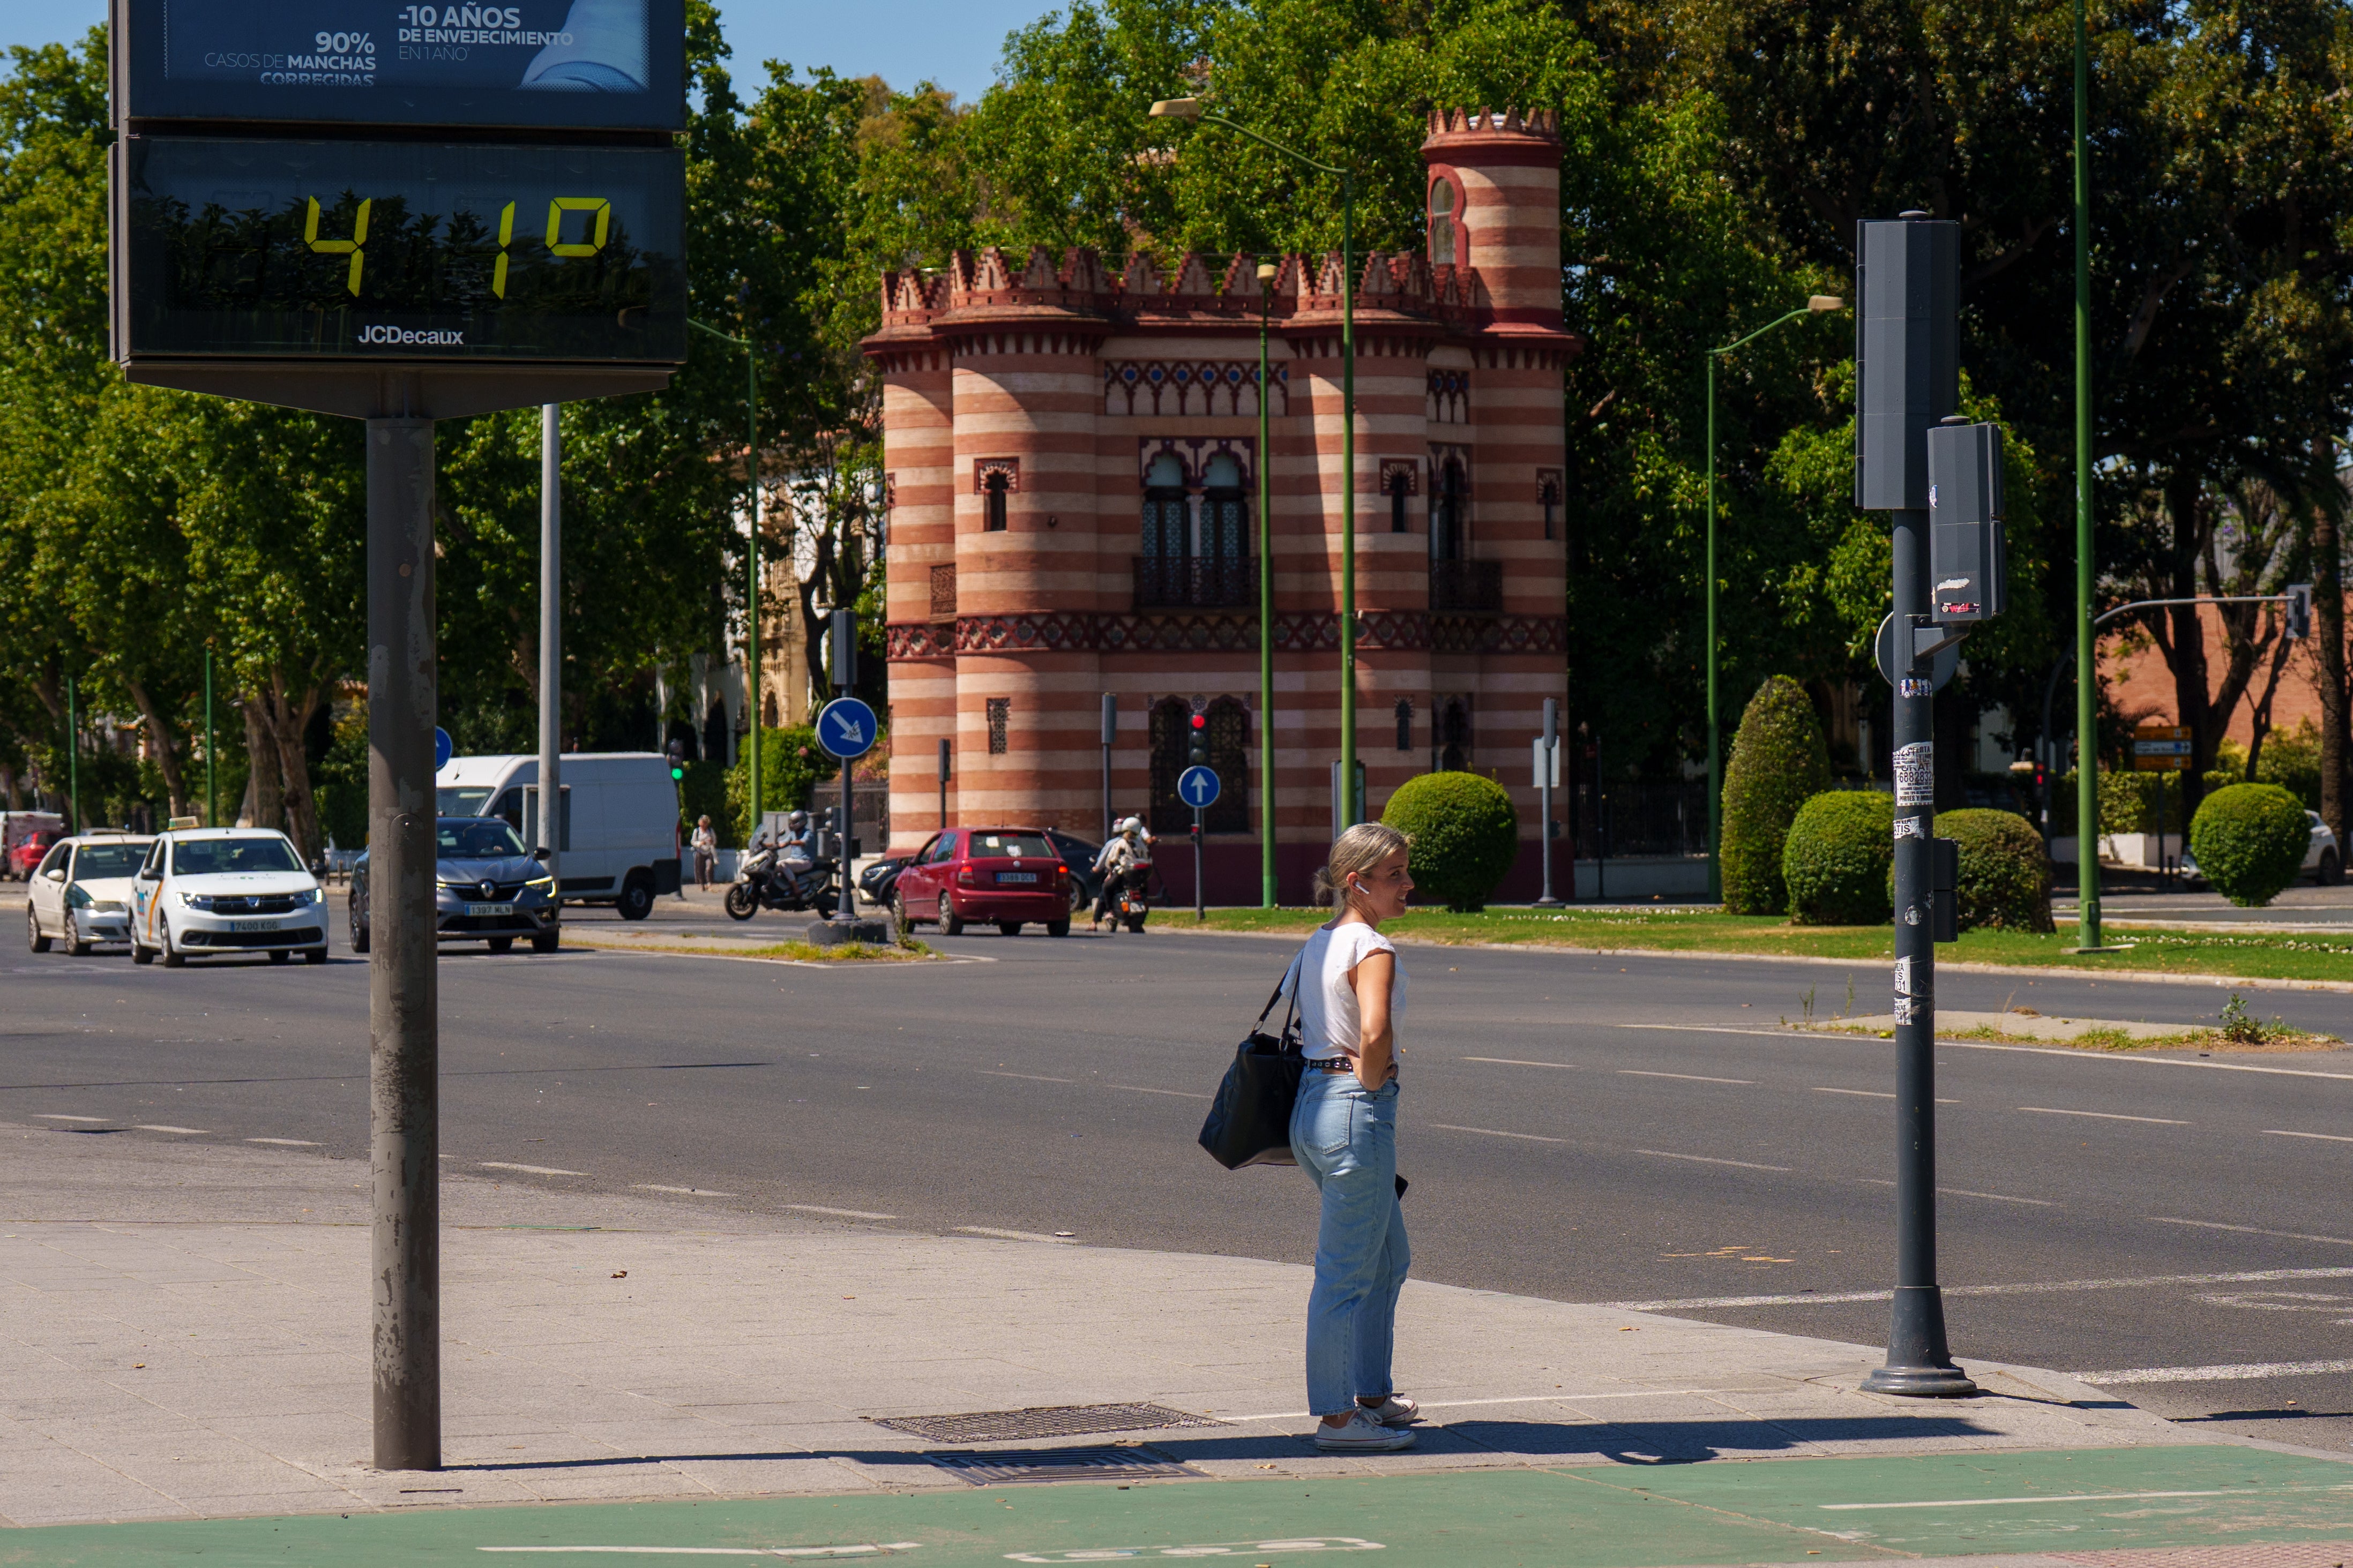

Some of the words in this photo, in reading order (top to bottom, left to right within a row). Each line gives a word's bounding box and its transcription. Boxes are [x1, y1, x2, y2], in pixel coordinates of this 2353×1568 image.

[399, 5, 437, 26] -10
[442, 1, 521, 29] AÑOS
[315, 31, 376, 54] 90%
[399, 28, 421, 42] DE
[425, 29, 573, 46] ENVEJECIMIENTO
[205, 52, 260, 68] CASOS
[264, 54, 284, 68] DE
[288, 55, 376, 70] MANCHAS
[399, 46, 420, 59] EN
[358, 325, 464, 345] JCDecaux
[236, 922, 258, 931] 7400
